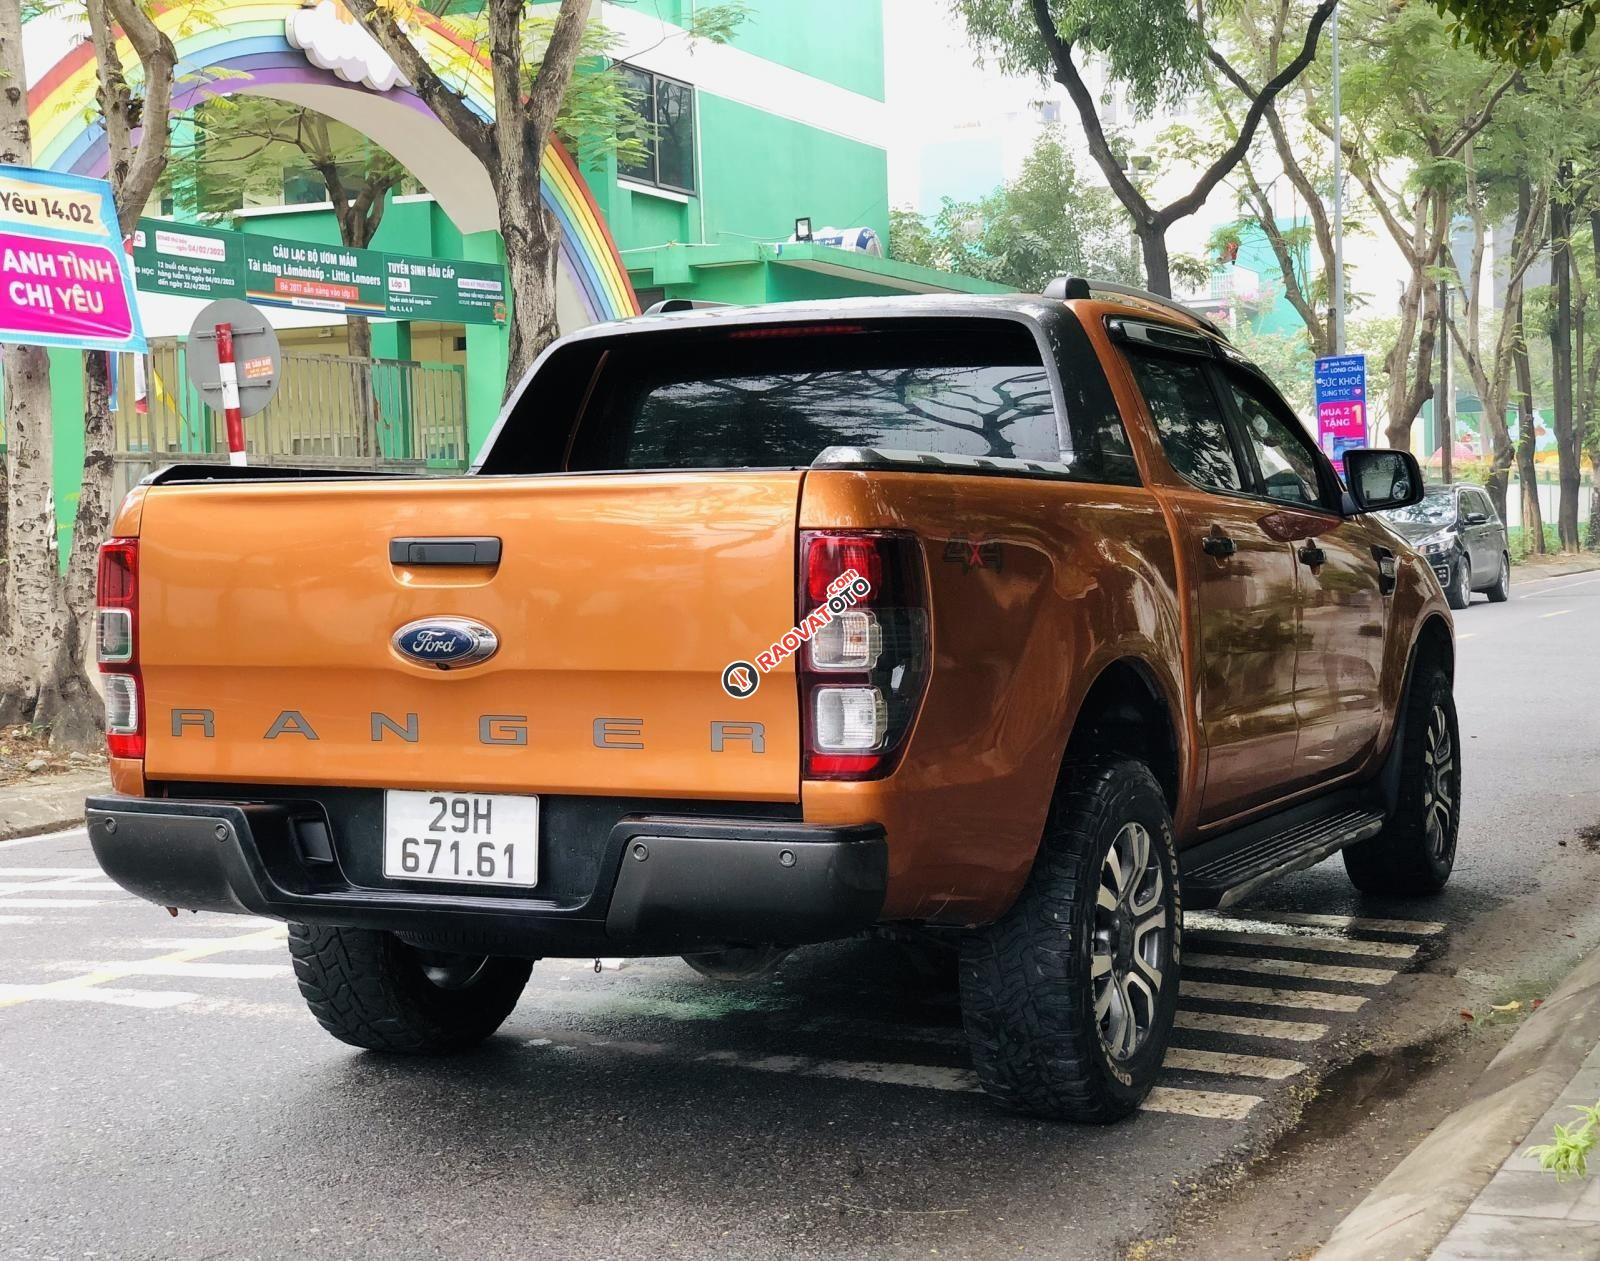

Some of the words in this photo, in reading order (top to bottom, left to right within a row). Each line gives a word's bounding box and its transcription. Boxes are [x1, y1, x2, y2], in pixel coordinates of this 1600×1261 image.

[0, 191, 38, 215] Yêu
[41, 198, 94, 224] 14.02
[272, 243, 289, 259] CÂU
[291, 248, 306, 263] LẠC
[307, 248, 319, 265] BỘ
[3, 248, 57, 277] ANH
[57, 250, 115, 284] TÌNH
[247, 258, 260, 271] Tài
[262, 261, 281, 276] năng
[331, 269, 350, 282] Little
[410, 264, 426, 276] SINH
[9, 281, 55, 315] CHỊ
[56, 284, 104, 315] YÊU
[1321, 377, 1337, 388] SỨC
[1320, 408, 1341, 416] MUA
[1324, 418, 1350, 429] TẶNG
[1352, 404, 1362, 425] 1
[412, 630, 457, 653] Ford
[171, 708, 766, 754] RANGER
[429, 796, 492, 834] 29H
[401, 837, 515, 879] 671.61
